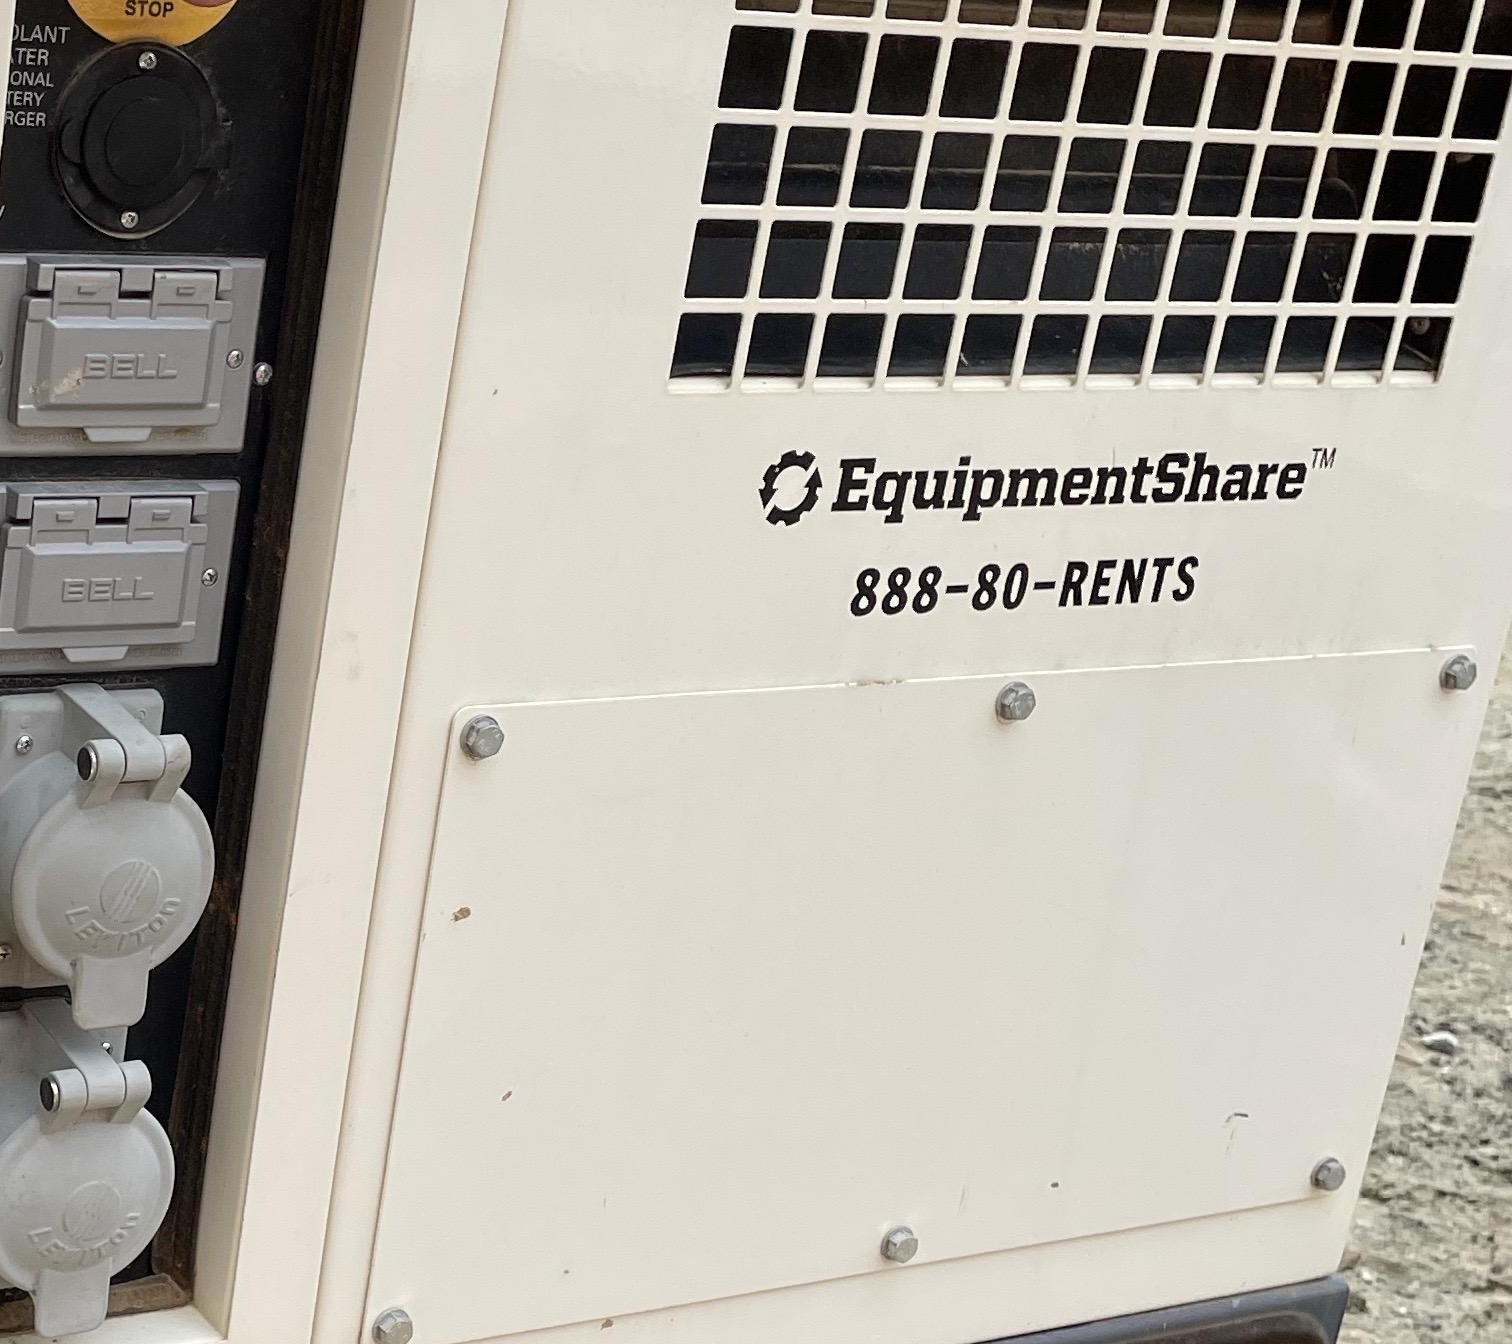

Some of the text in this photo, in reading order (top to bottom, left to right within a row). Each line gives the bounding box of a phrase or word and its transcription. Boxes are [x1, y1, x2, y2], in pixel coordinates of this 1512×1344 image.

[124, 0, 175, 18] STOP
[85, 353, 179, 380] BELL
[61, 575, 155, 603] BELL
[849, 555, 1200, 617] 888-80-RENTS
[64, 896, 182, 953] LEVITON
